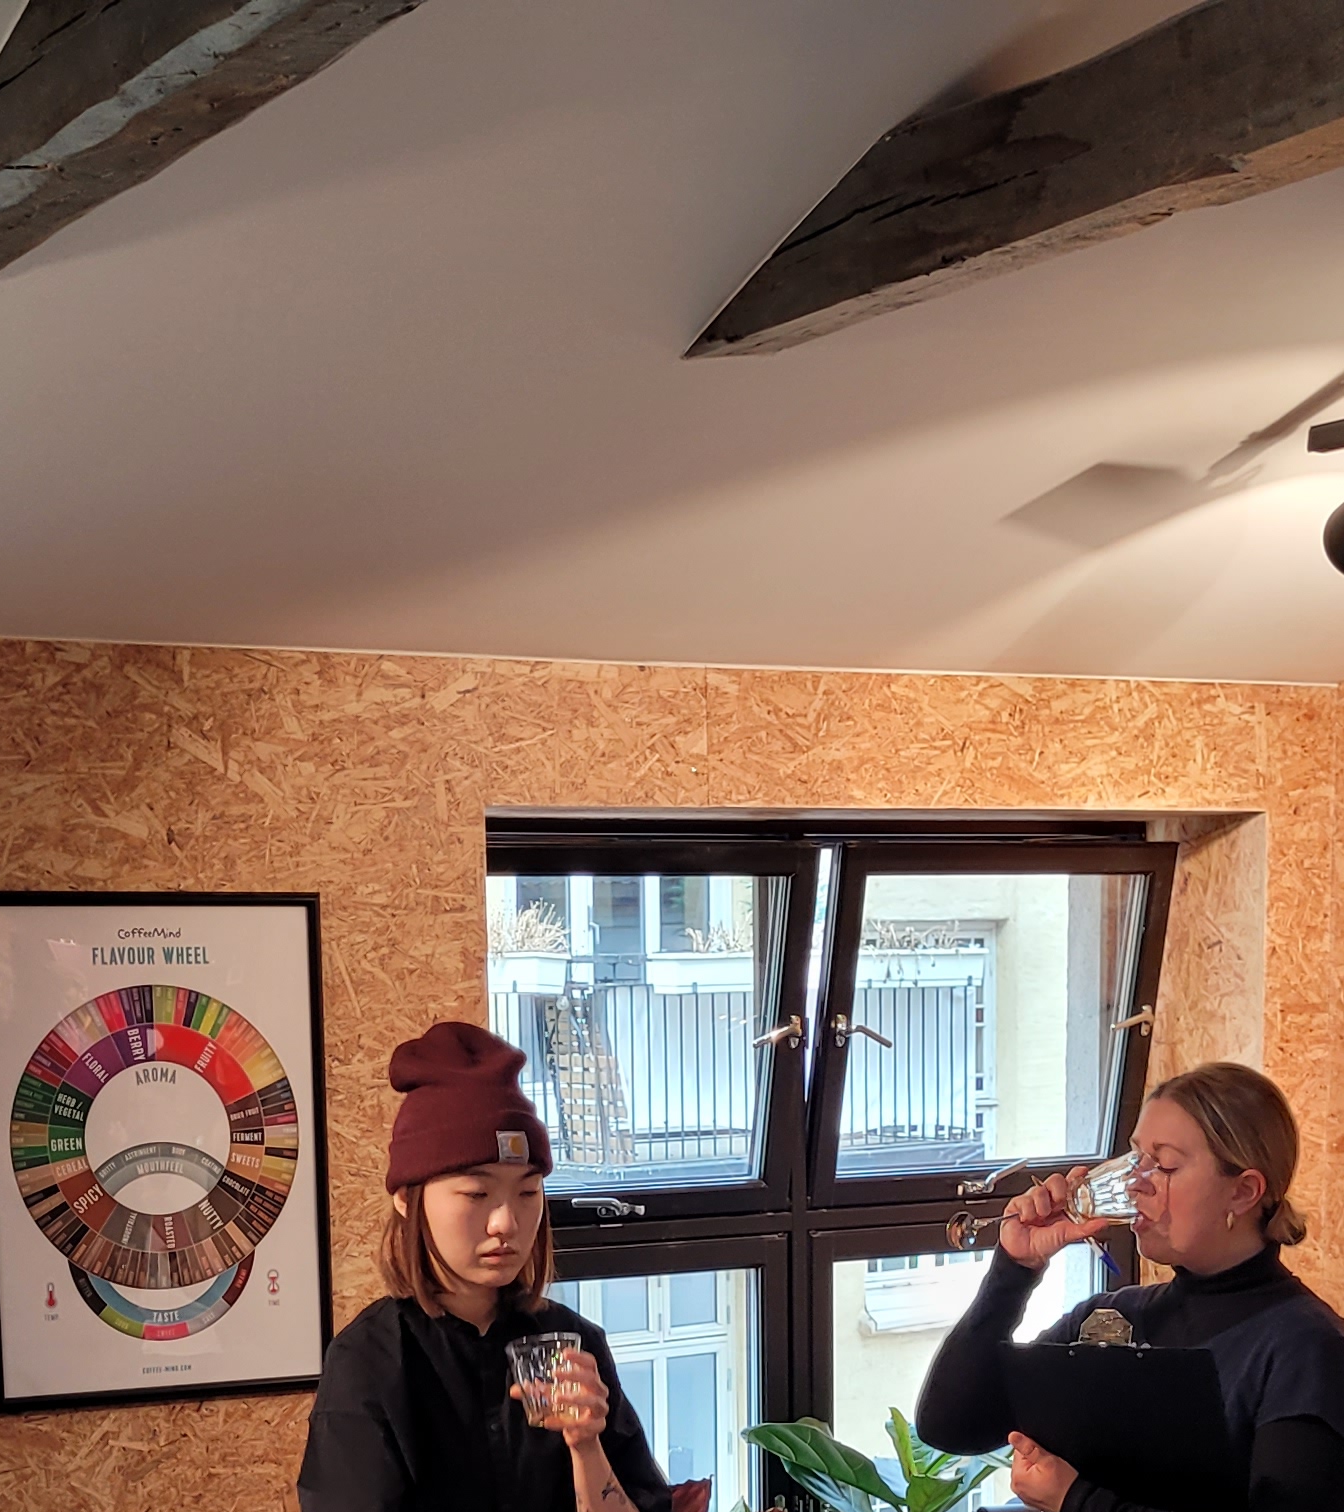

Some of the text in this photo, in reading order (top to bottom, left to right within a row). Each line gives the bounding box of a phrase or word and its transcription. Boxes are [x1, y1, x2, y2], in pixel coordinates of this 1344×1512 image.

[117, 927, 182, 940] CoffeeMind
[92, 946, 209, 966] FLAVOUR WHEEL
[127, 1028, 146, 1062] BERRY
[194, 1042, 217, 1073] FRUITY
[81, 1053, 109, 1084] FLORAL
[135, 1067, 177, 1086] AROMA
[56, 1093, 76, 1108] HERB
[54, 1105, 84, 1122] VEGETAL
[50, 1137, 83, 1152] GREEN
[232, 1132, 262, 1142] FERMENT
[56, 1158, 89, 1177] CEREAL
[136, 1160, 184, 1175] MOUTHFEEL
[230, 1152, 261, 1169] SWEETS
[222, 1175, 250, 1197] CHOCOLATE
[73, 1183, 104, 1214] SPICY
[198, 1199, 224, 1230] NUTTY
[152, 1310, 180, 1323] TASTE
